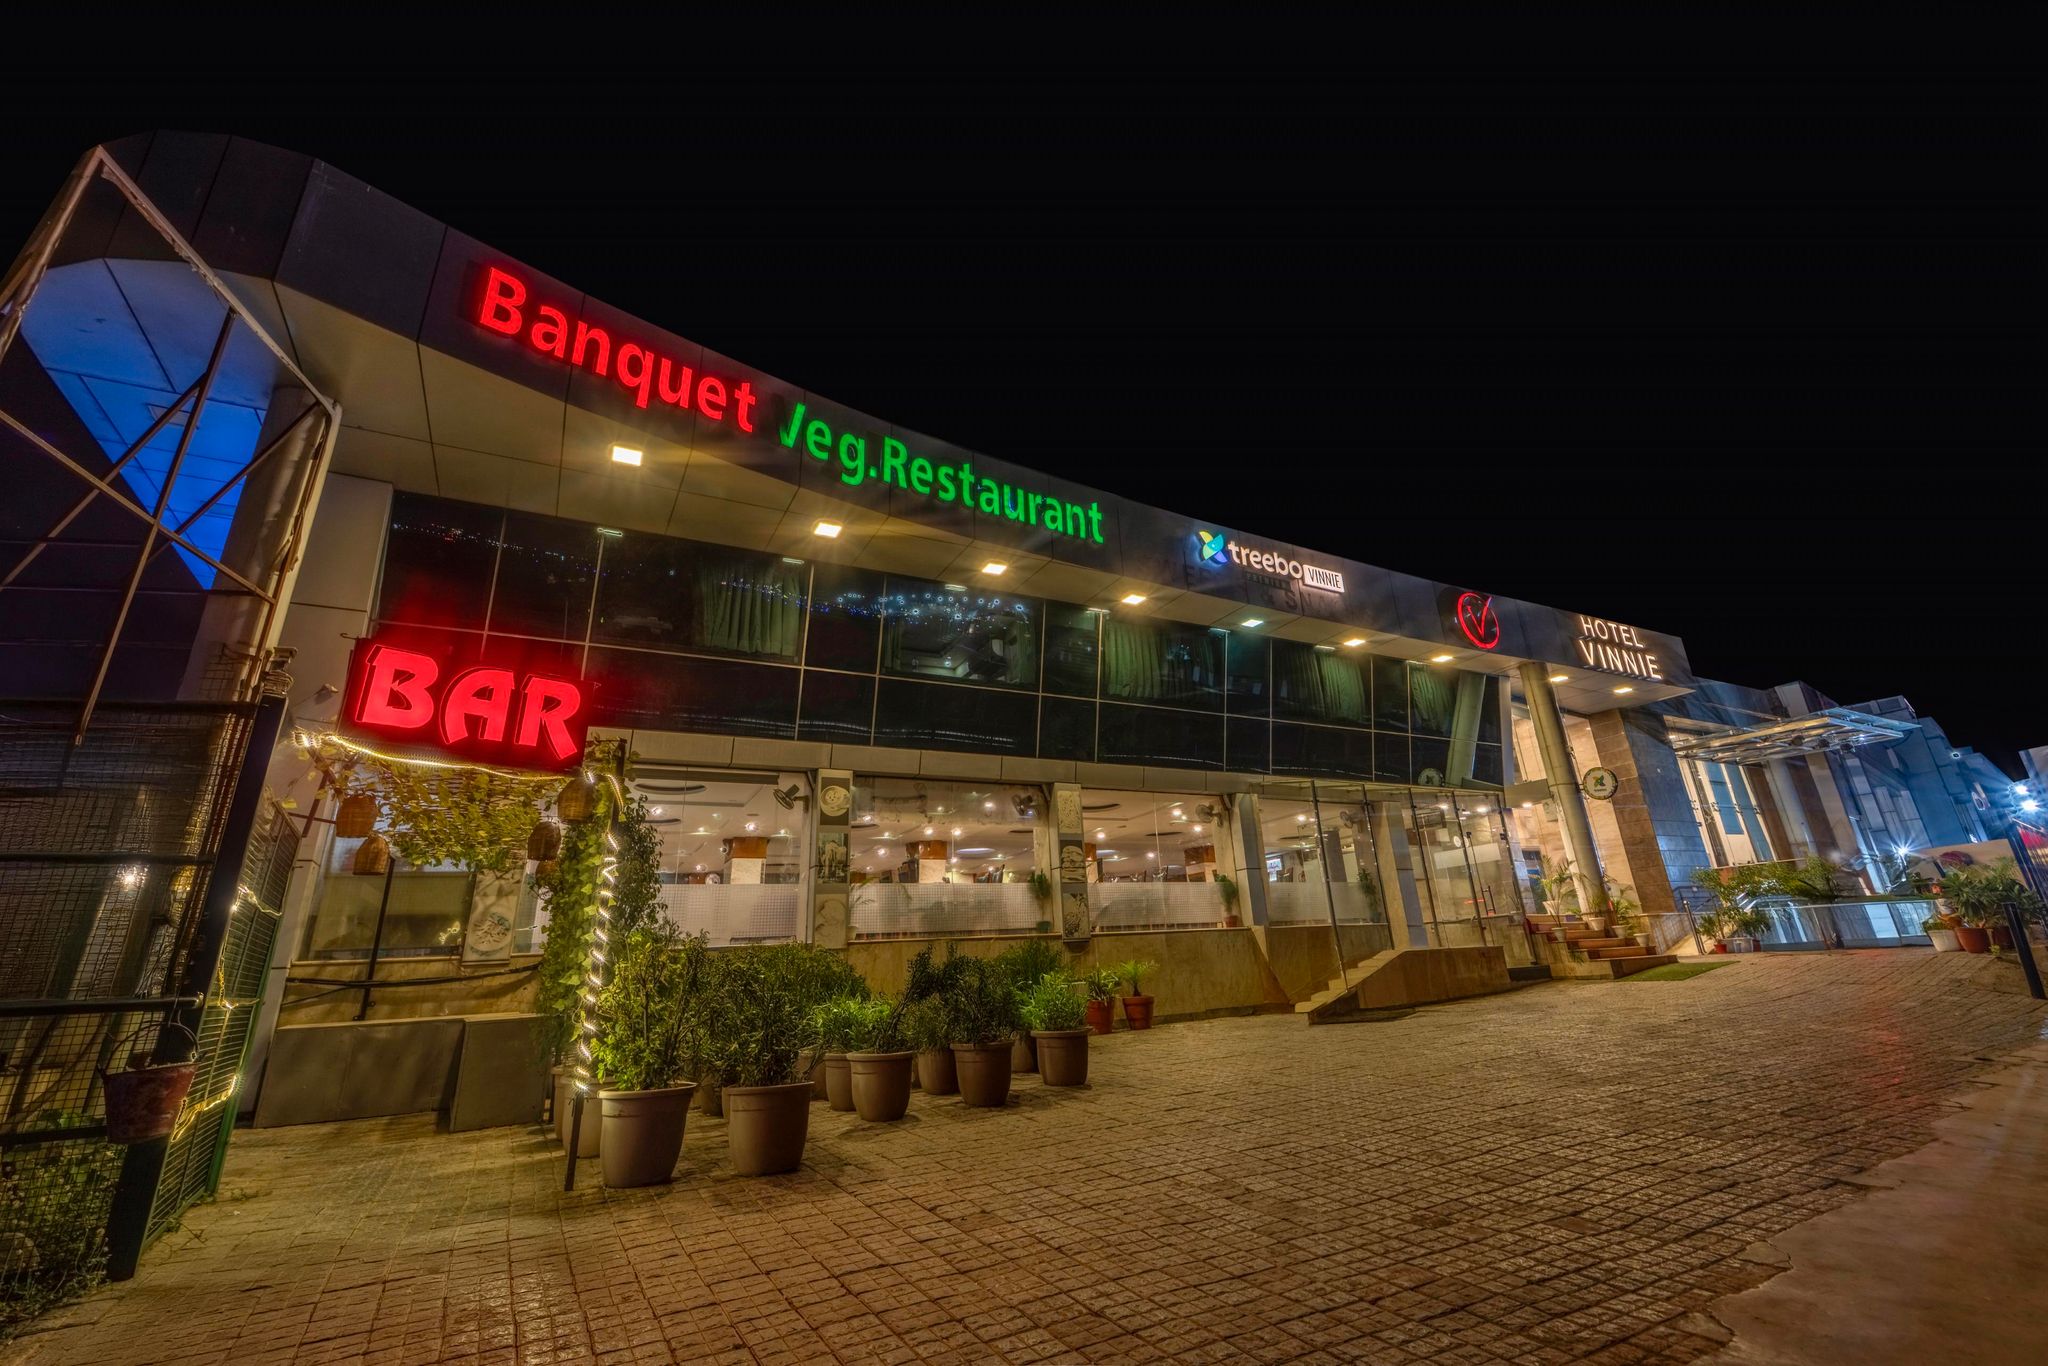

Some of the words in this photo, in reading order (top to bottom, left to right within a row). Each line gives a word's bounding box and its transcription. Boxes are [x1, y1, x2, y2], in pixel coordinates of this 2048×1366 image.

[480, 267, 756, 433] Banquet
[1227, 541, 1303, 579] treebo
[1308, 567, 1341, 589] VINNIE
[1580, 615, 1644, 648] HOTEL
[1579, 640, 1662, 680] VINNIE
[355, 645, 581, 759] BAR
